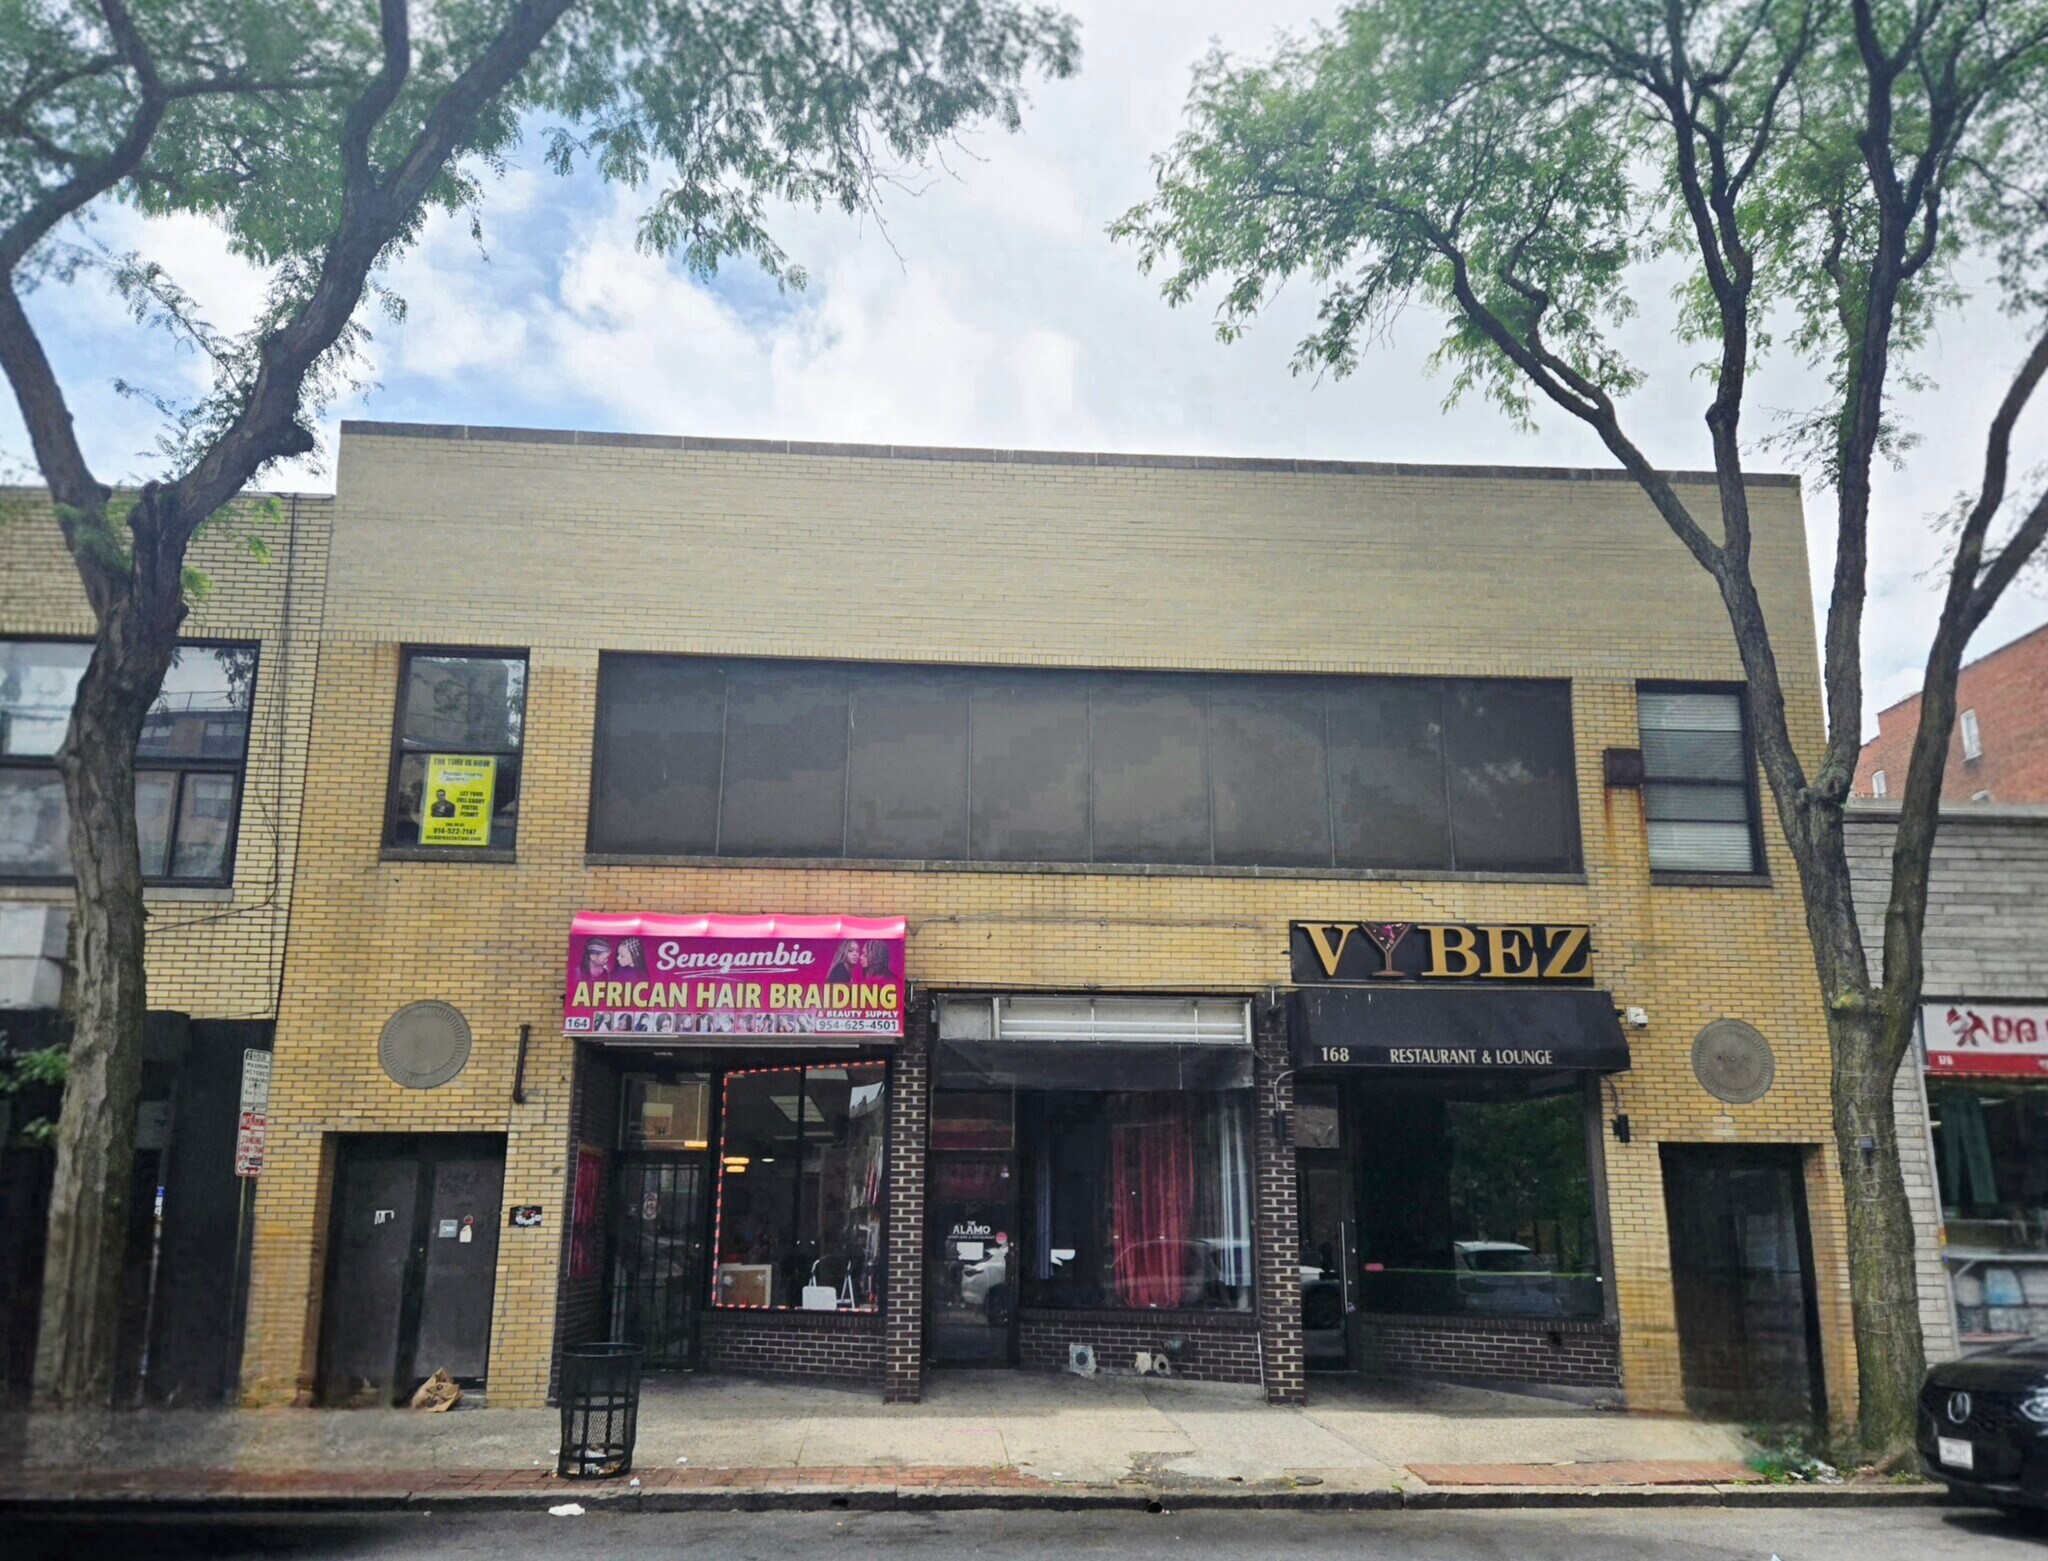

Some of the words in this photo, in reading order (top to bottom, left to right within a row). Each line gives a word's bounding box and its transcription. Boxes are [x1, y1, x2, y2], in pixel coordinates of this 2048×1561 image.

[656, 941, 816, 973] Senegambia
[571, 981, 688, 1009] AFRICAN
[696, 982, 762, 1010] HAIR
[769, 983, 897, 1010] BRAIDING
[818, 1010, 824, 1018] &
[827, 1010, 862, 1018] BEAUTY
[865, 1010, 899, 1018] SUPPLY
[567, 1018, 588, 1028] 164
[820, 1020, 896, 1030] 954-625-4501
[1321, 1047, 1349, 1062] 168
[1390, 1049, 1476, 1064] RESTAURANT
[1482, 1050, 1492, 1063] &
[1497, 1050, 1553, 1065] LOUNGE
[953, 1225, 991, 1235] ALAMO
